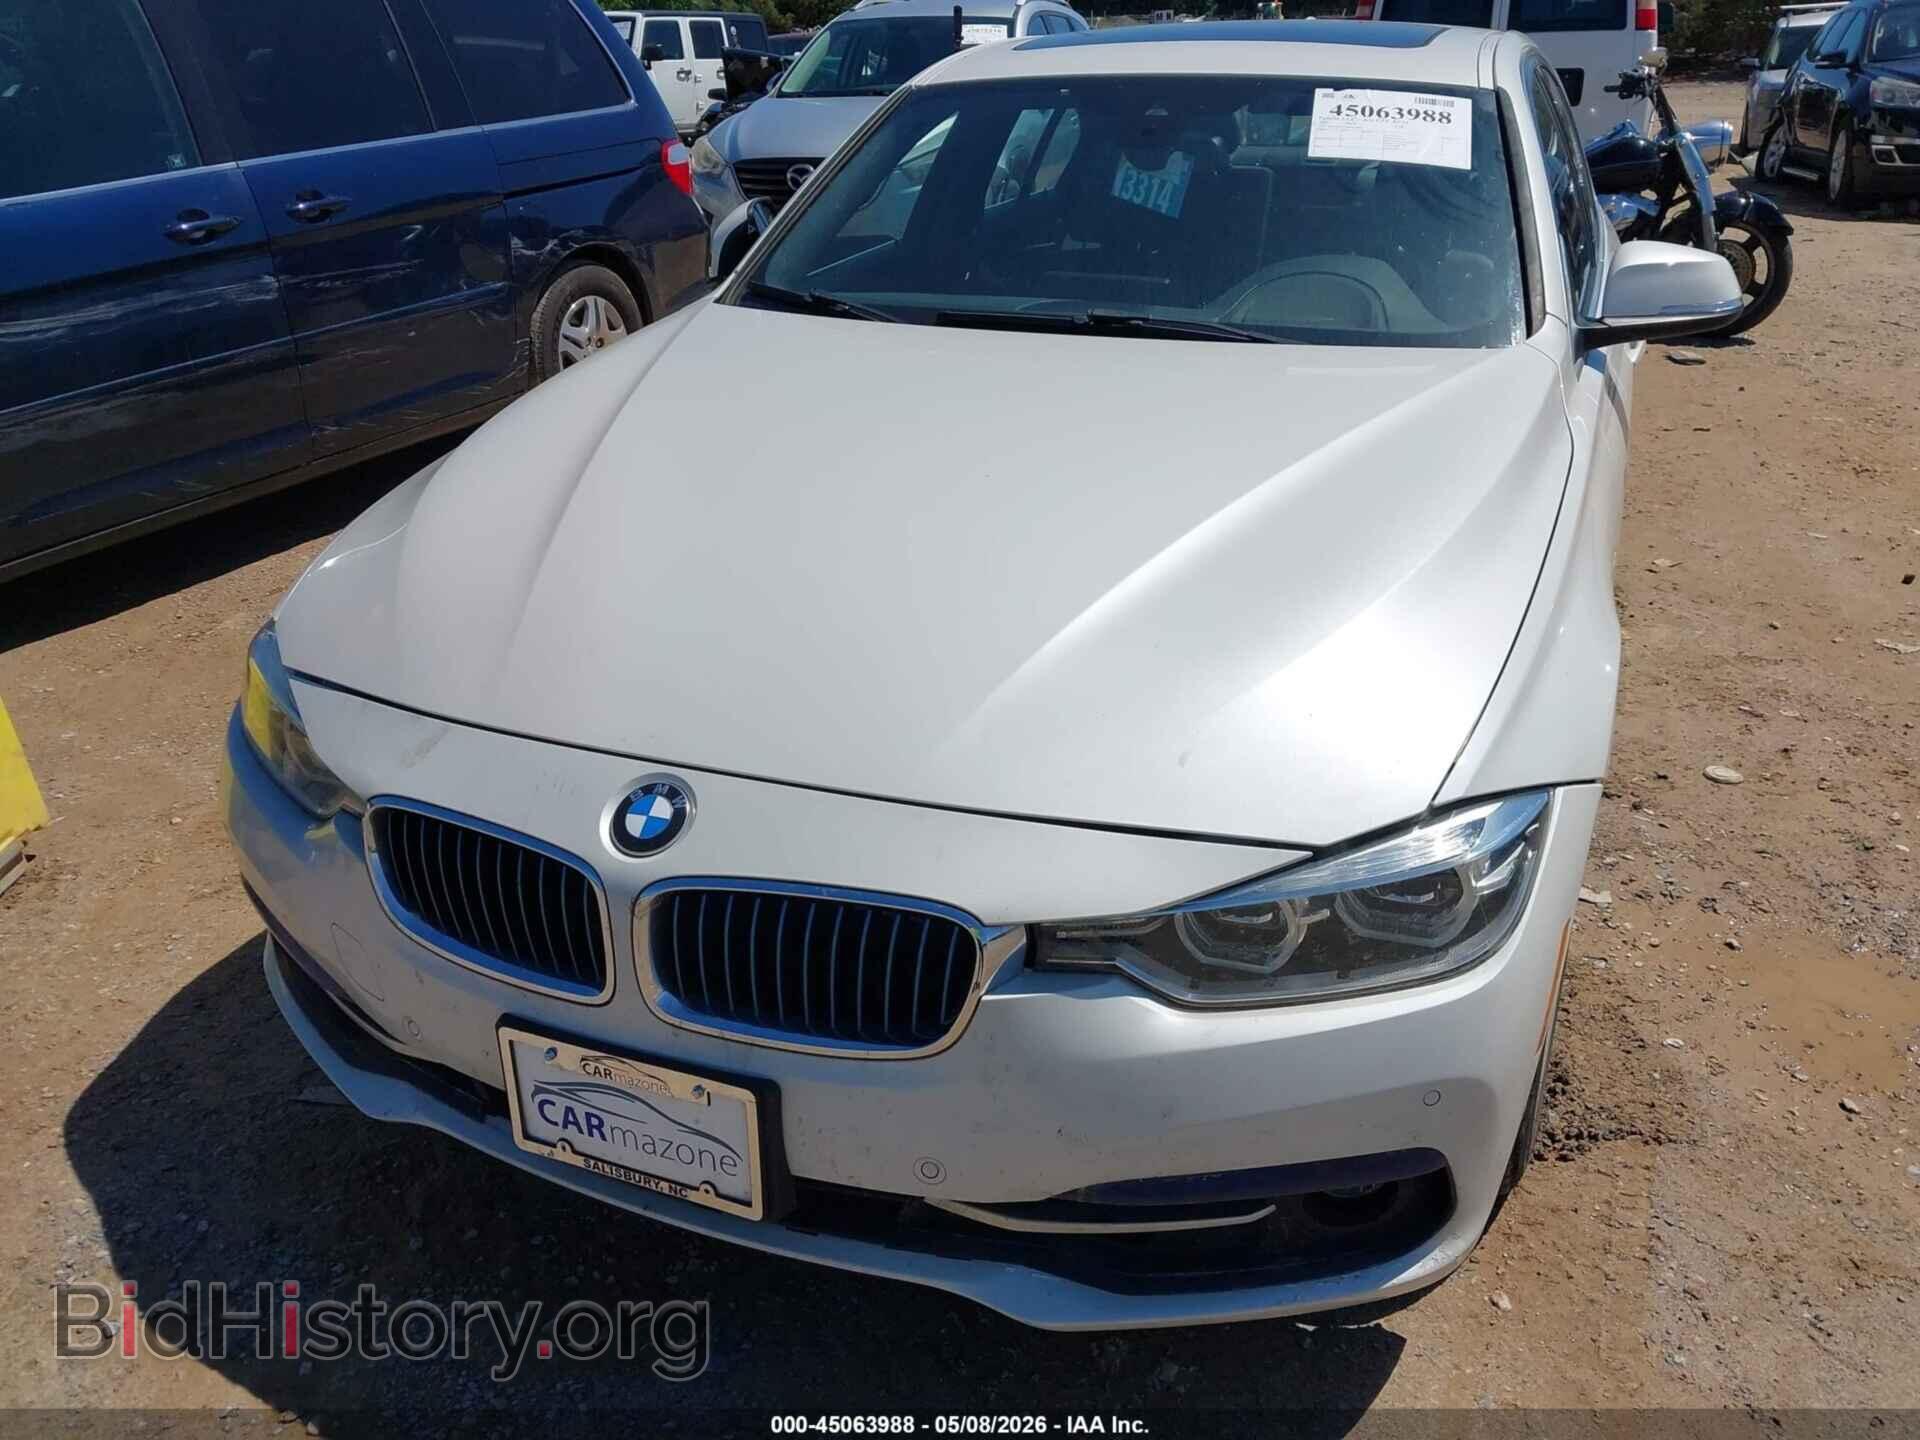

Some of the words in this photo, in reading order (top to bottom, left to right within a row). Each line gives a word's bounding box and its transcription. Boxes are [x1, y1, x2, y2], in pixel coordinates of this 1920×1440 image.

[1329, 103, 1453, 125] 45063988
[629, 783, 688, 809] BMW
[537, 1099, 738, 1177] CARmazone
[583, 1158, 664, 1192] SALISBURY,
[668, 1184, 689, 1199] NC
